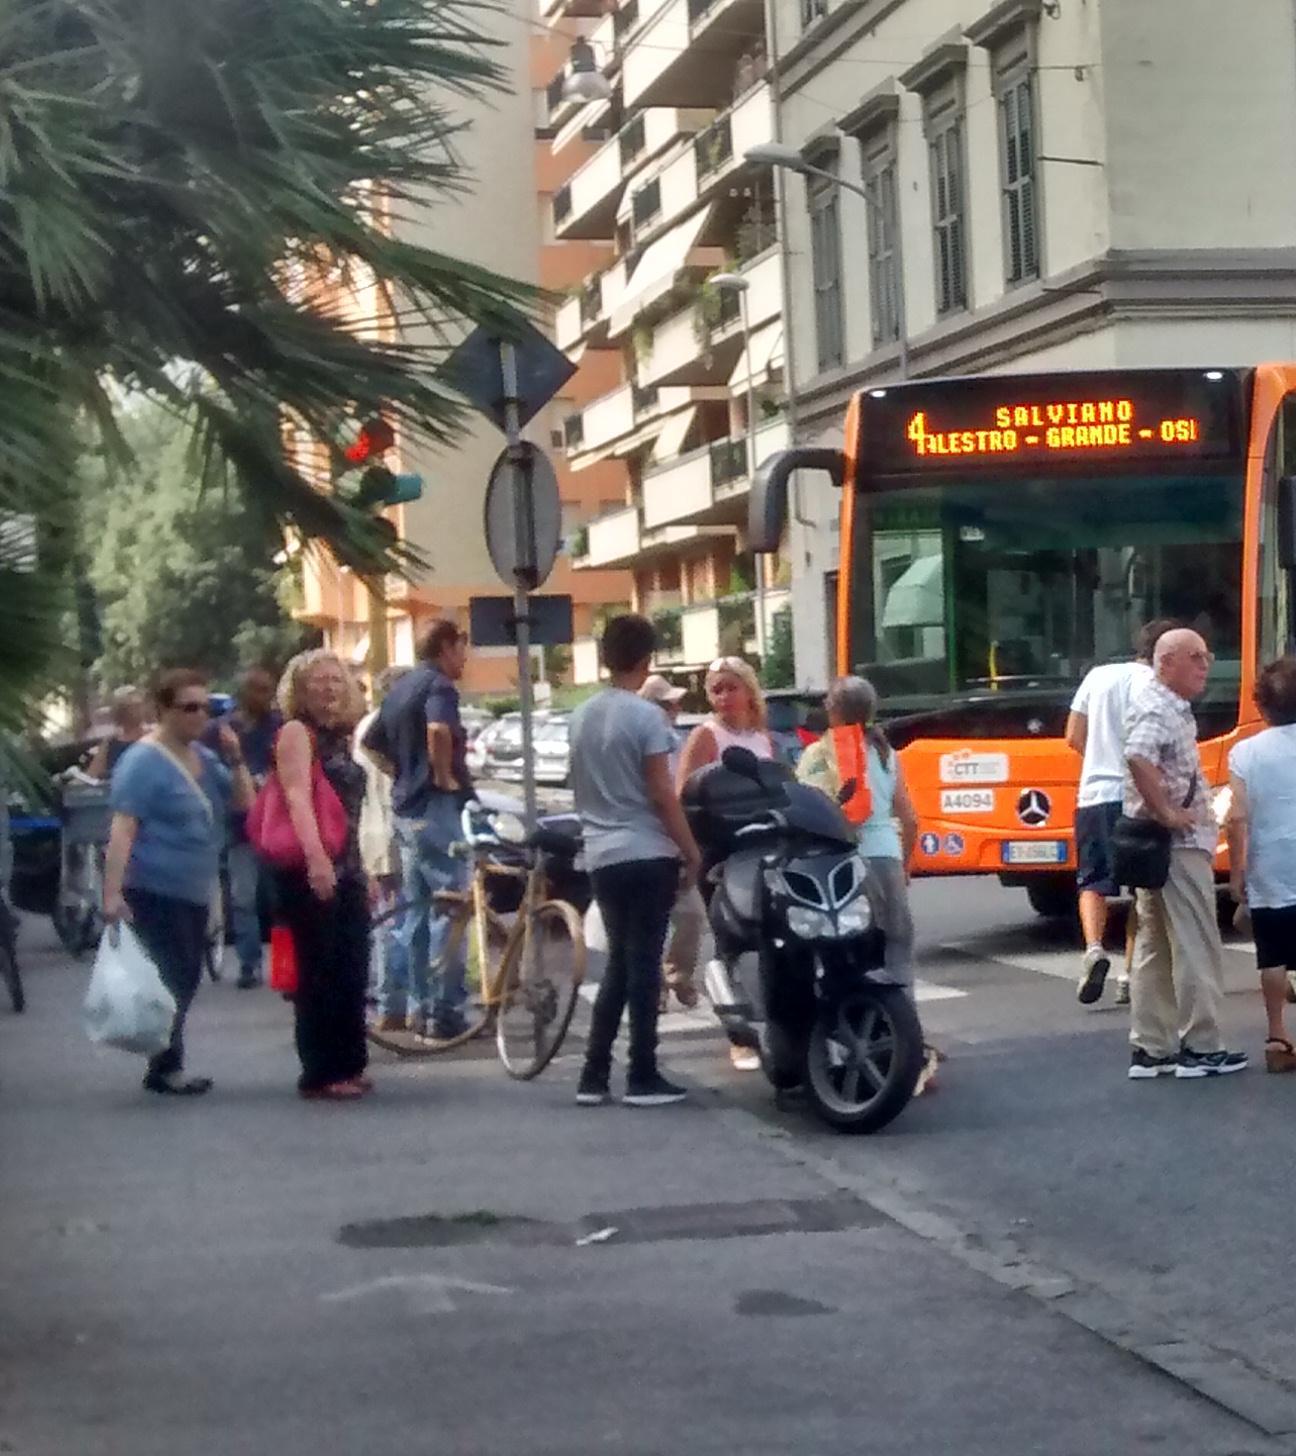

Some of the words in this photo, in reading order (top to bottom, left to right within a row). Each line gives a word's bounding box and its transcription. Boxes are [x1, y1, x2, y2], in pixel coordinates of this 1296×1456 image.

[996, 400, 1132, 428] SALVIANO
[907, 411, 925, 455] 4
[1046, 423, 1132, 448] GRANDE
[1161, 419, 1196, 442] OS
[954, 762, 979, 775] CTT
[944, 793, 992, 809] A4094
